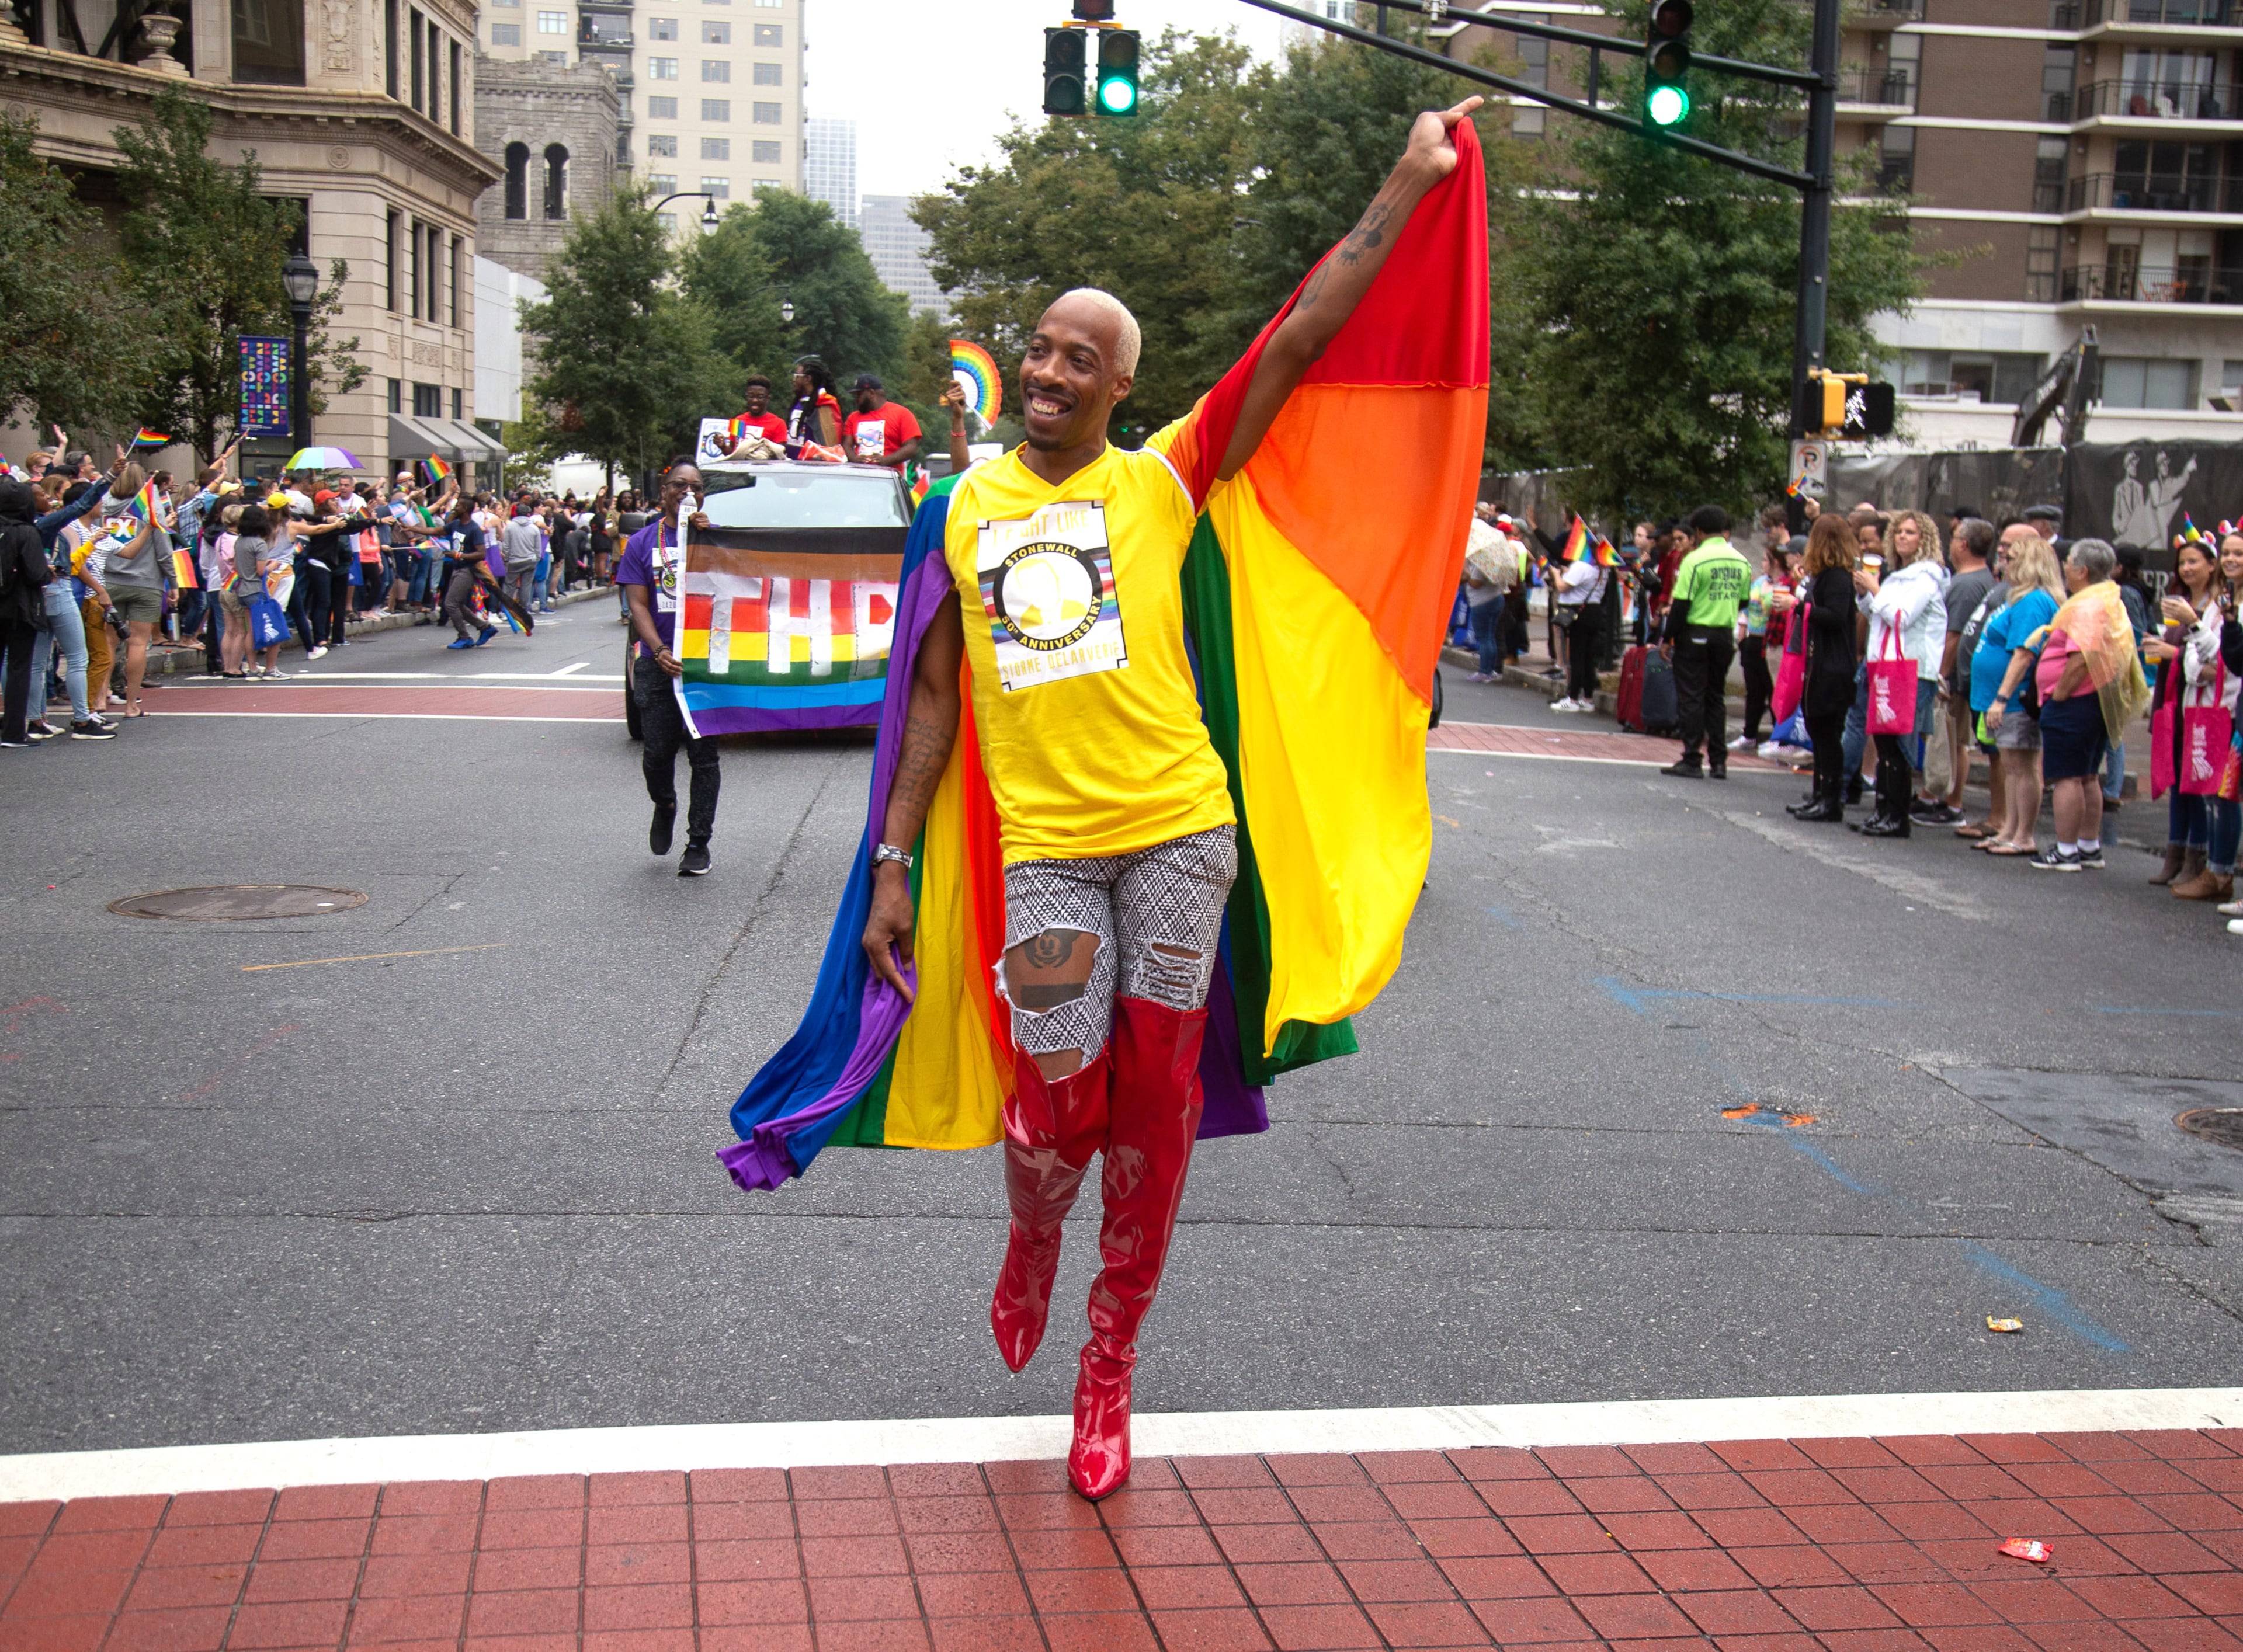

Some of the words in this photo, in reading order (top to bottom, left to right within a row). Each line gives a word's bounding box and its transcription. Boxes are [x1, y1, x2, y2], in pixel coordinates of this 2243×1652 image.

[241, 342, 256, 423] MIDTOWN
[256, 343, 271, 423] MIDTOWN
[272, 343, 287, 425] MIDTOWN
[1057, 509, 1089, 533] LIKE
[1005, 544, 1077, 568] STONEWALL
[1020, 596, 1102, 651] ANNIVERSARY
